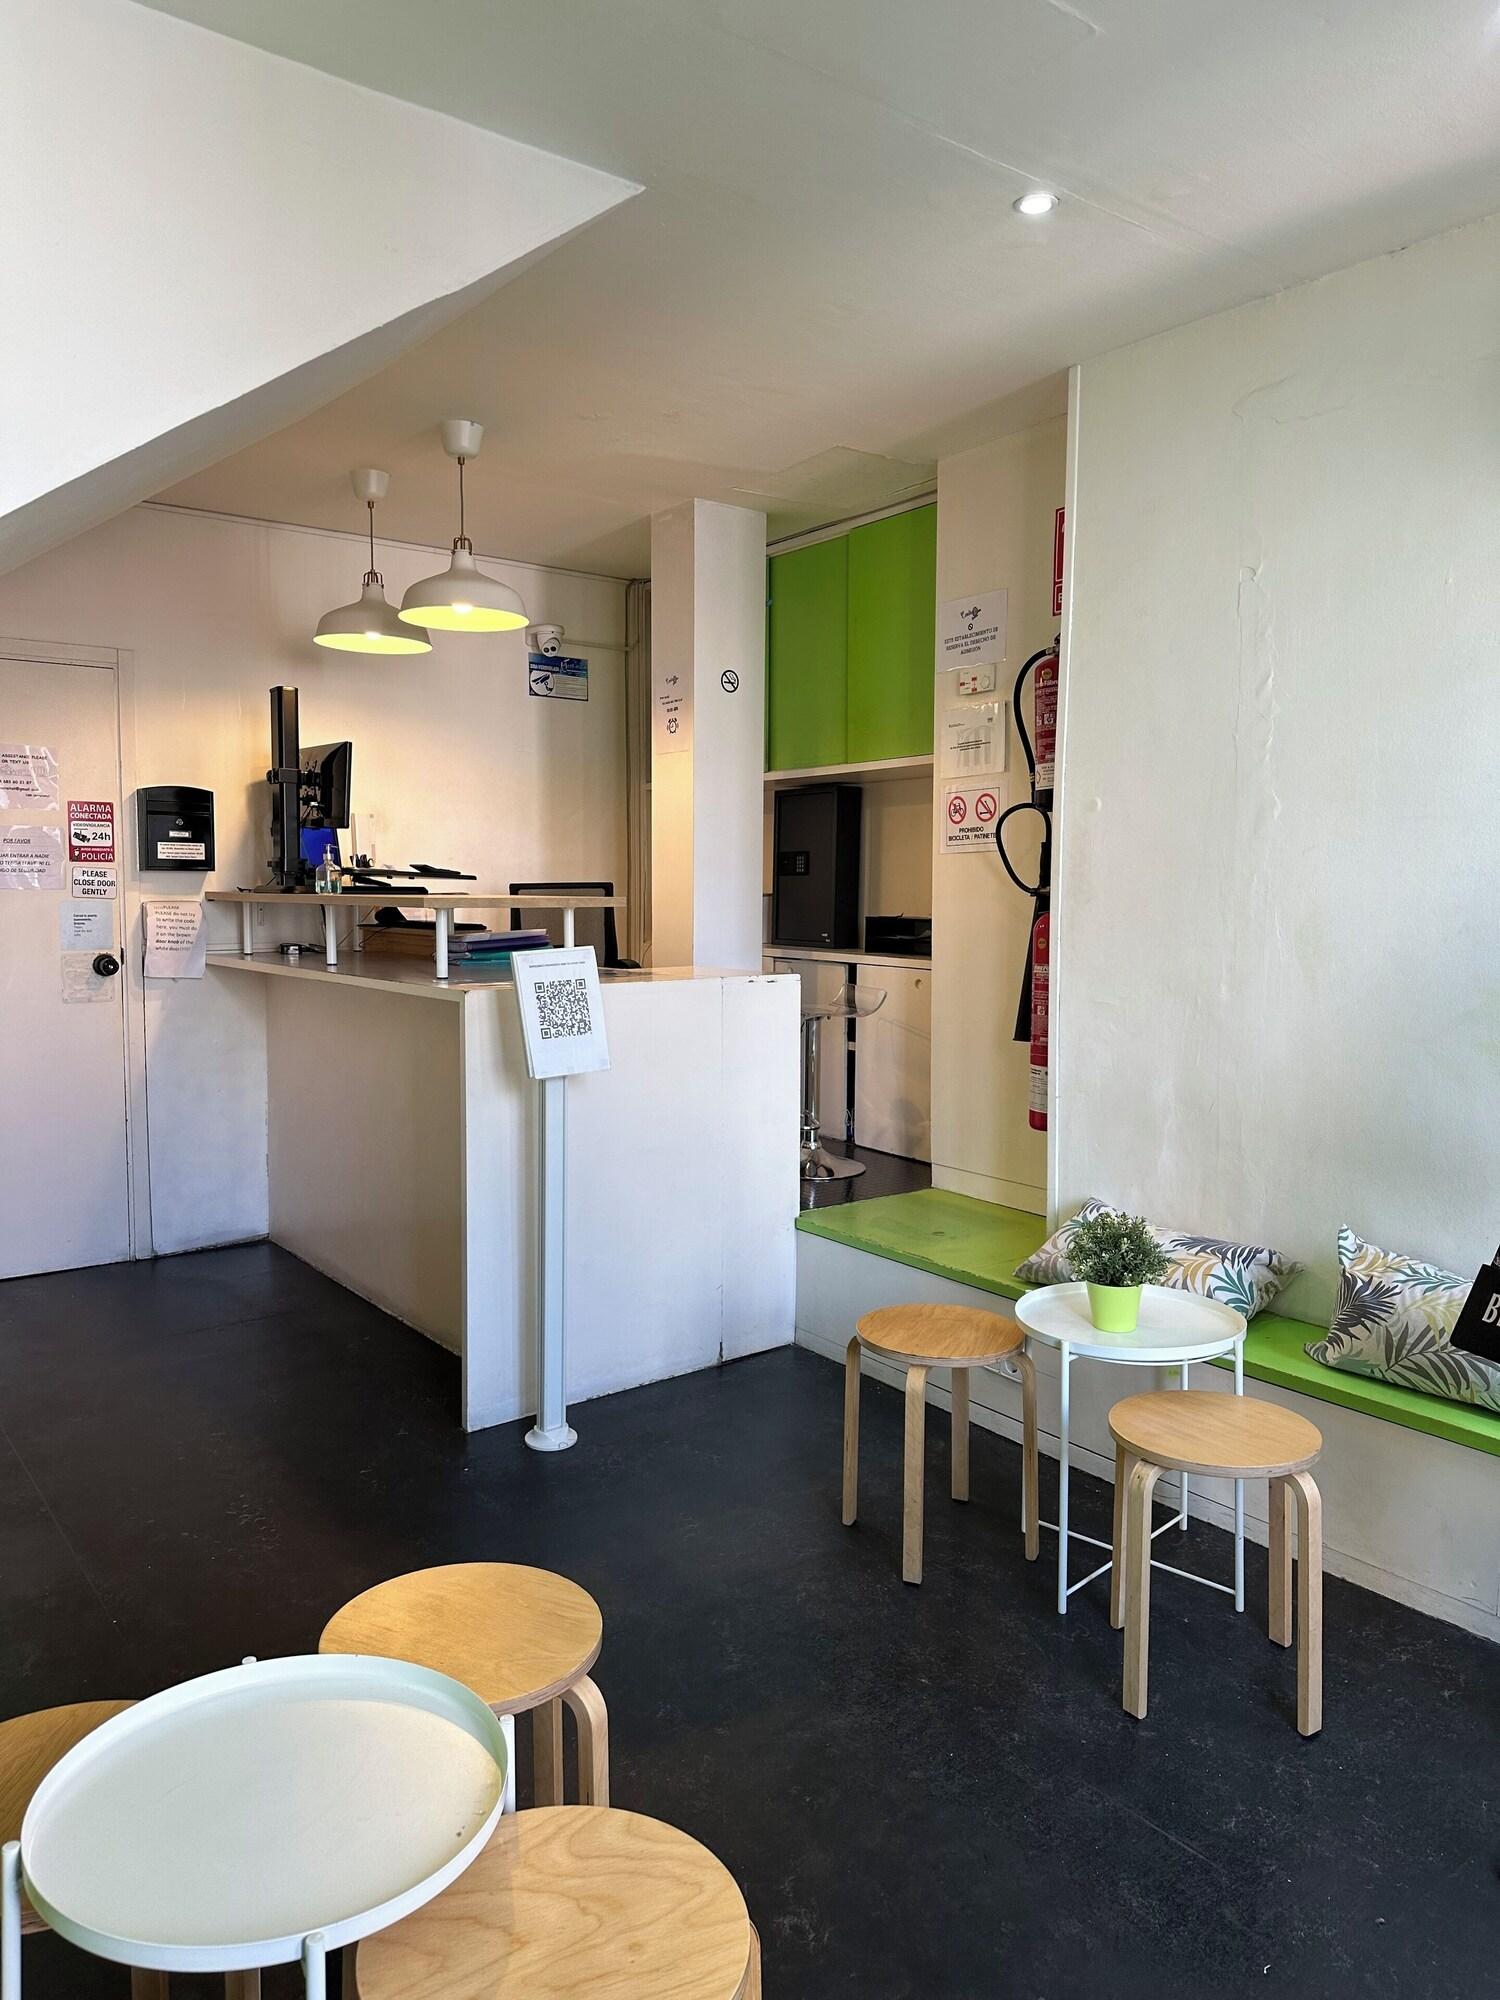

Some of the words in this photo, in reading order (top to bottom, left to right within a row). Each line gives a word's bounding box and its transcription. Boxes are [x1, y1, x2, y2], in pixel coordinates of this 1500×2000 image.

[70, 804, 112, 812] ALARMA
[92, 832, 111, 841] 24h
[81, 852, 114, 860] POLICIA
[1482, 1292, 1500, 1327] B
